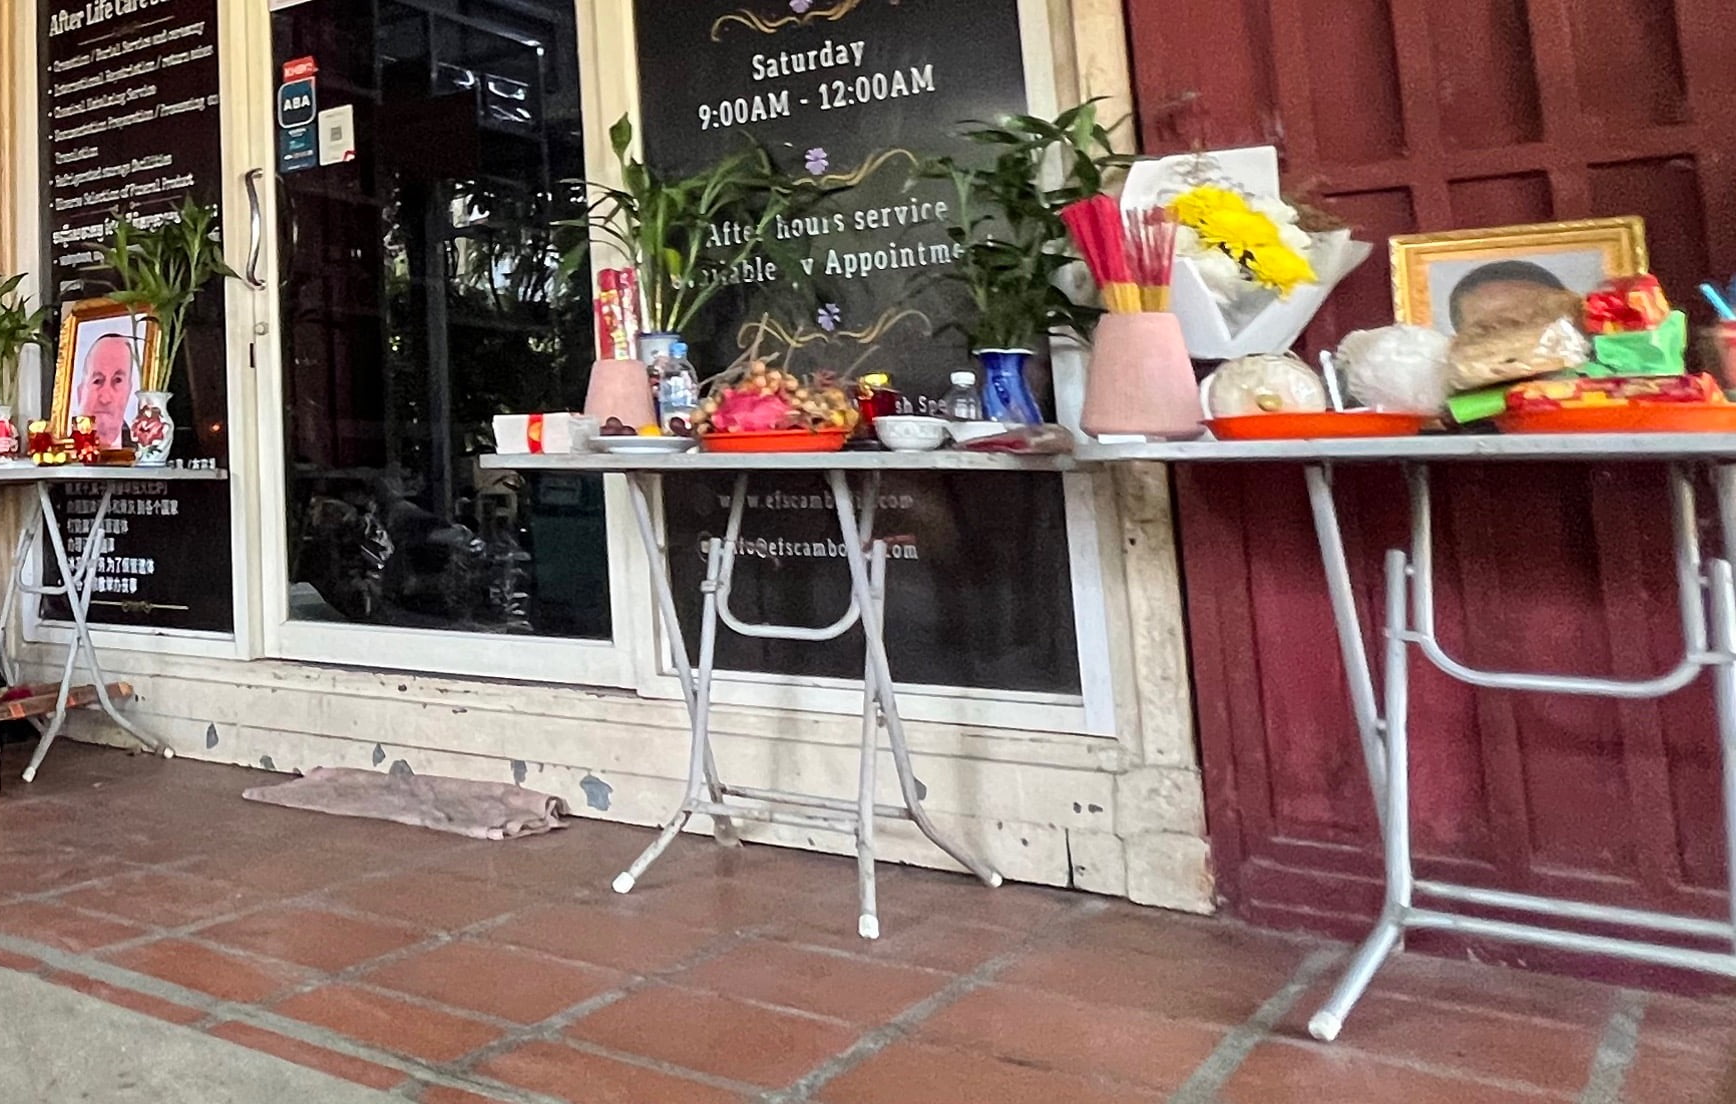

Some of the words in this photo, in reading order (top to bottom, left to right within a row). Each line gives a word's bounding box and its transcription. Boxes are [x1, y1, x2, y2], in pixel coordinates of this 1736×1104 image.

[49, 9, 84, 37] After
[752, 40, 865, 81] Saturday
[283, 95, 311, 111] ABA
[698, 91, 791, 130] 9:00AM
[818, 64, 936, 110] 12:00AM
[854, 197, 949, 231] service
